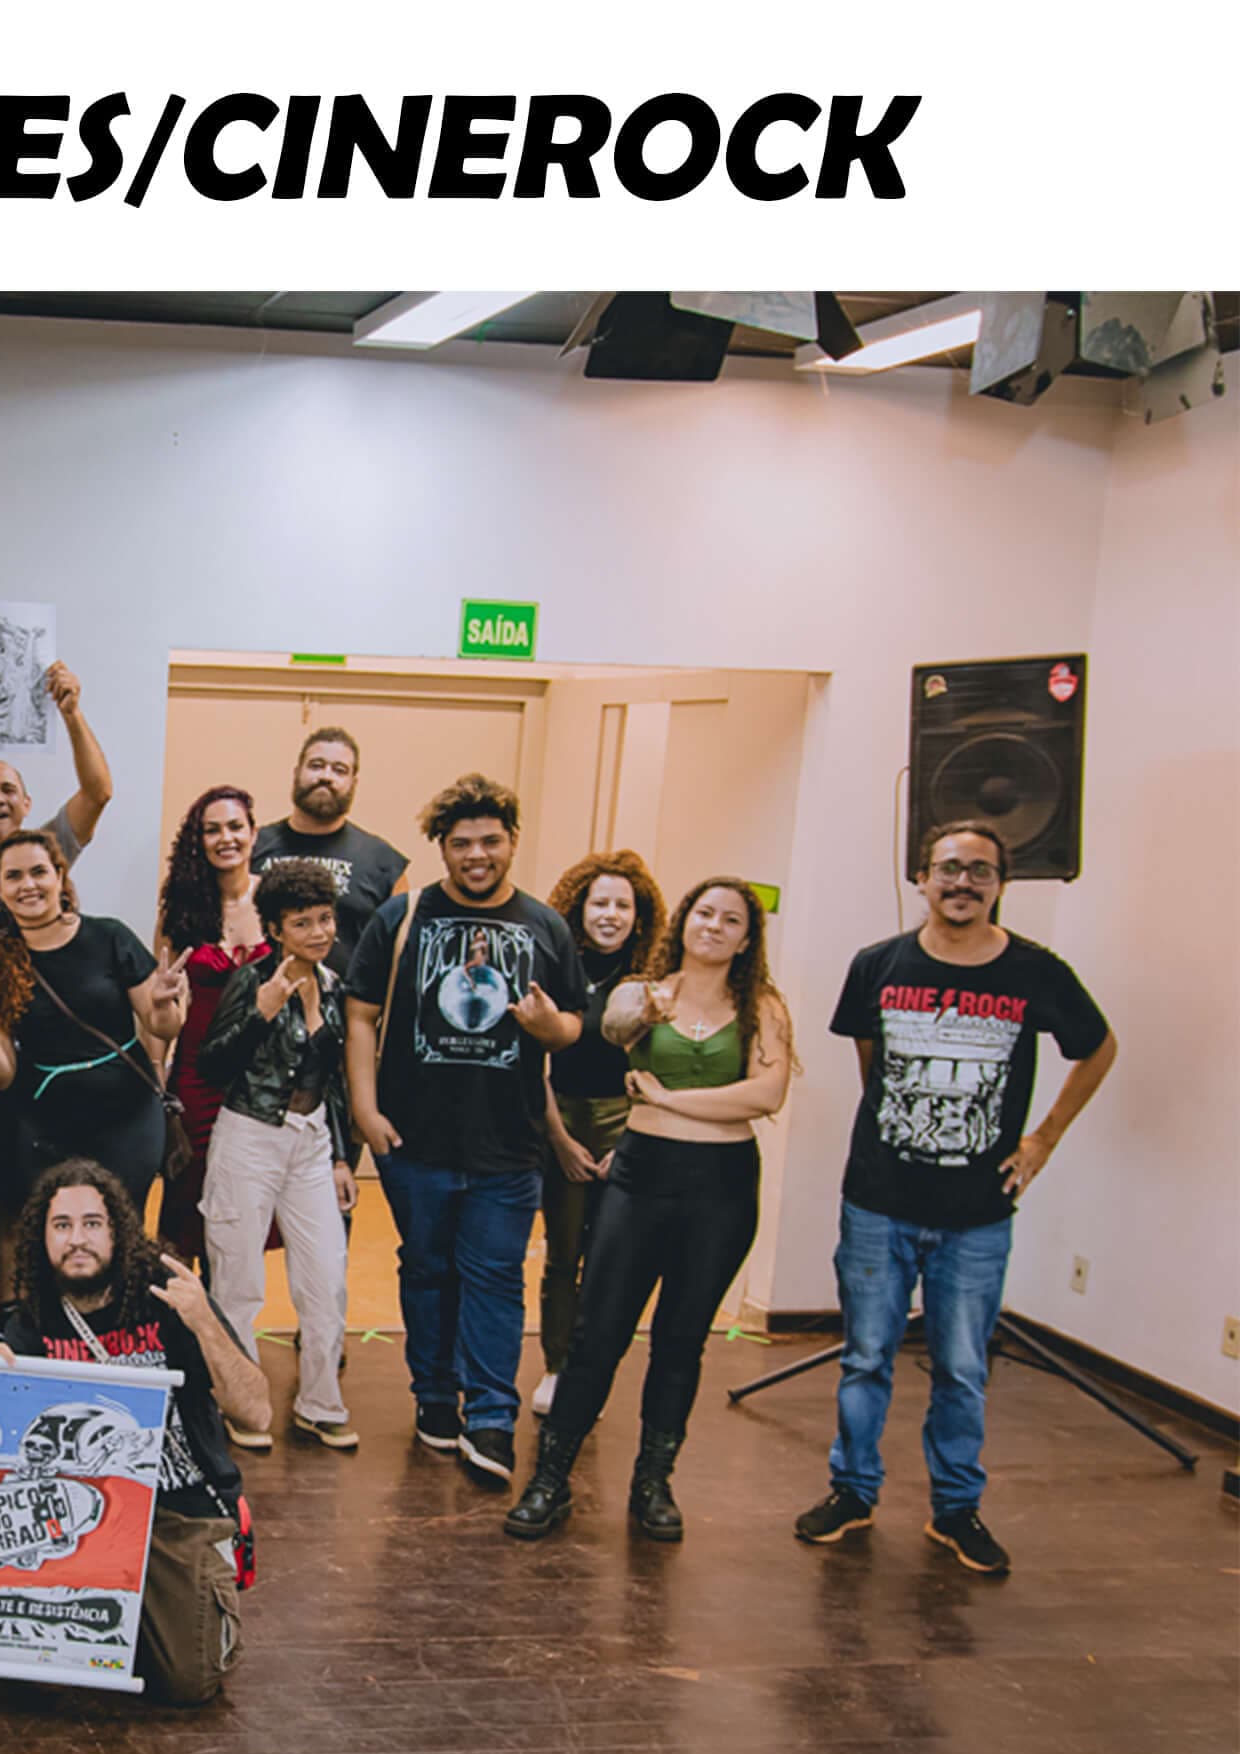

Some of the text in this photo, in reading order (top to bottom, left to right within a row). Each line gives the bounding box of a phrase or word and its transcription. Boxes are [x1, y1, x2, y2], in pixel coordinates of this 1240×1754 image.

[467, 614, 529, 647] SAÍDA
[880, 985, 938, 1012] CINE
[957, 991, 1028, 1023] ROCK
[16, 1600, 26, 1615] E
